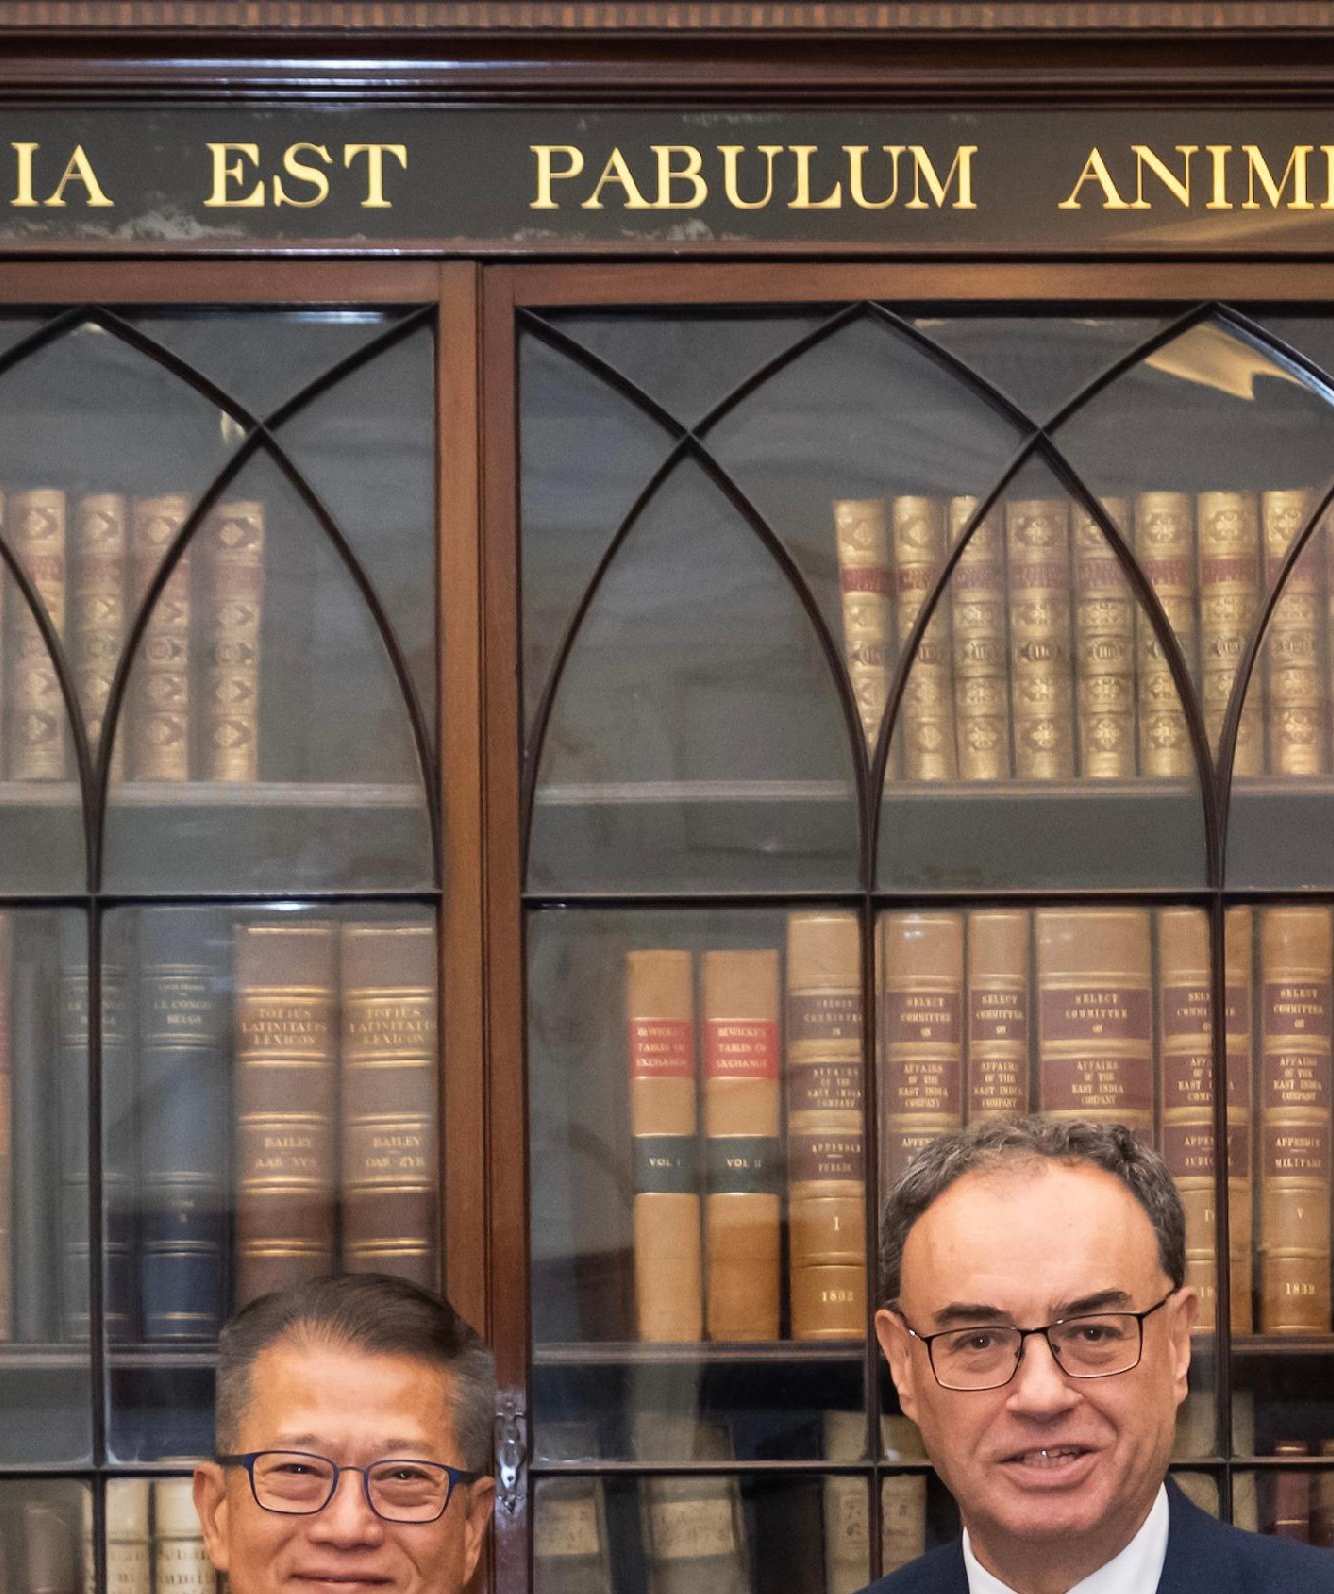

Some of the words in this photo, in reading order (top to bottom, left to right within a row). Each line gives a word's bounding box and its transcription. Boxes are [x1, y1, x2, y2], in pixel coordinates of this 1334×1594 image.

[203, 142, 408, 208] EST
[529, 145, 977, 210] PABULUM
[254, 1034, 317, 1046] LEXICON
[364, 1033, 426, 1045] LEXICON
[264, 1137, 313, 1148] BAILEY
[372, 1136, 422, 1148] BAILEY
